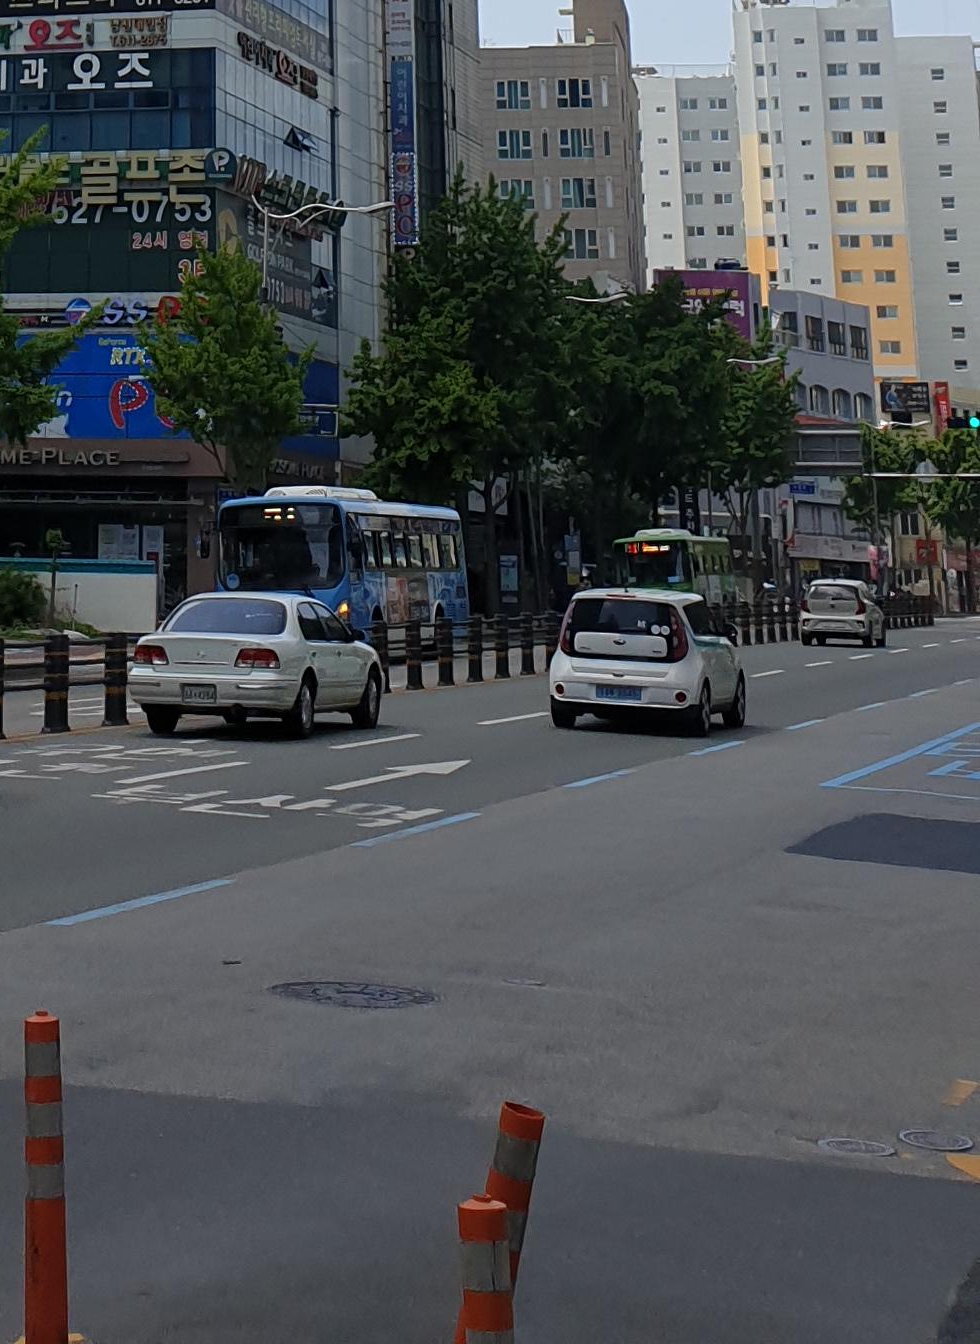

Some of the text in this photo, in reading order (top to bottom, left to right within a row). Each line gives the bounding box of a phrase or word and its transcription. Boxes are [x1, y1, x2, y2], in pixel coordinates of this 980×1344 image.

[23, 18, 85, 52] 오즈
[66, 51, 154, 91] 오즈
[80, 150, 206, 204] 골프존
[132, 230, 168, 250] 24시
[40, 446, 120, 466] PLACE
[90, 784, 446, 828] 부산역
